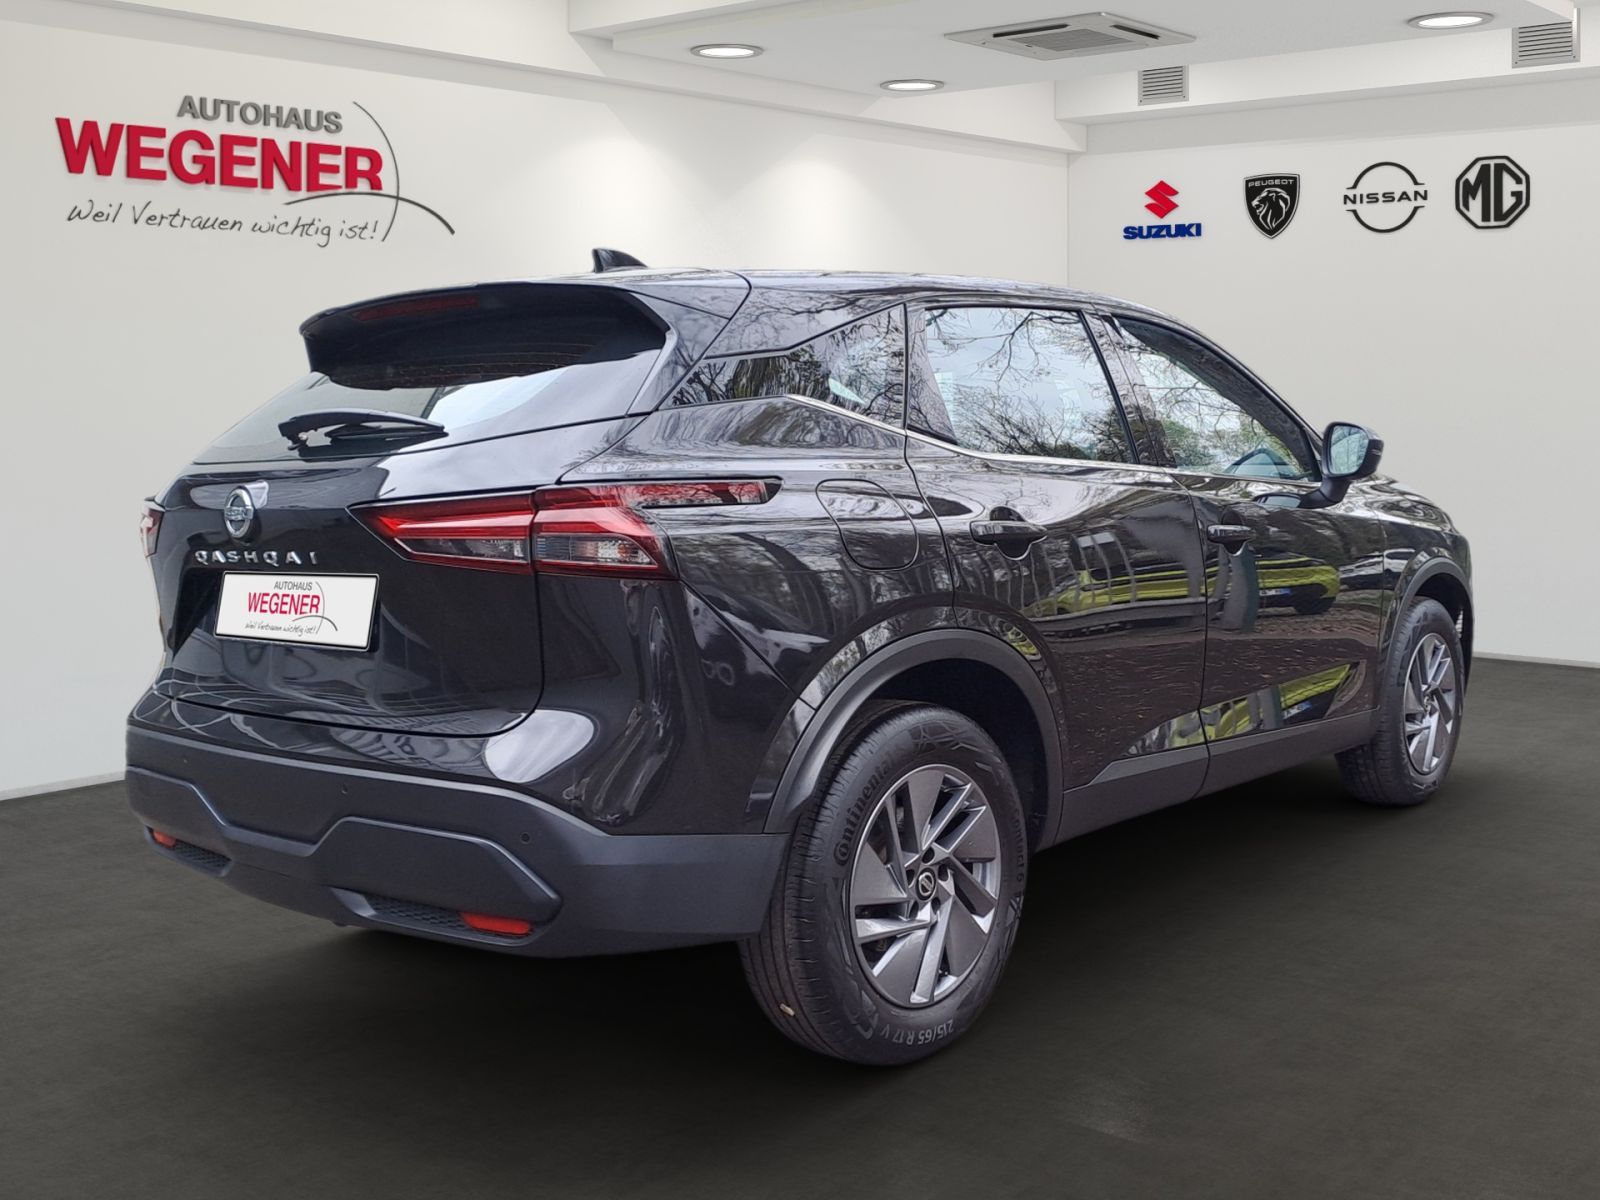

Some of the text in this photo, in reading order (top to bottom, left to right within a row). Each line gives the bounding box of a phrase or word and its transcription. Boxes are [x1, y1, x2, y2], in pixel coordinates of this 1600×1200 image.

[177, 95, 342, 133] AUTOHAUS
[55, 117, 383, 192] WEGENER
[1248, 178, 1295, 188] PEUGEOT
[1461, 162, 1523, 222] MG
[1343, 189, 1428, 206] NISSAN
[67, 200, 377, 247] Weil Vertrauen wichtig ist!
[1123, 223, 1201, 240] SUZUKI
[195, 550, 318, 567] QASHQAI
[274, 581, 313, 591] AUTOHAUS
[248, 592, 321, 615] WEGENER
[918, 1019, 954, 1045] 215/65
